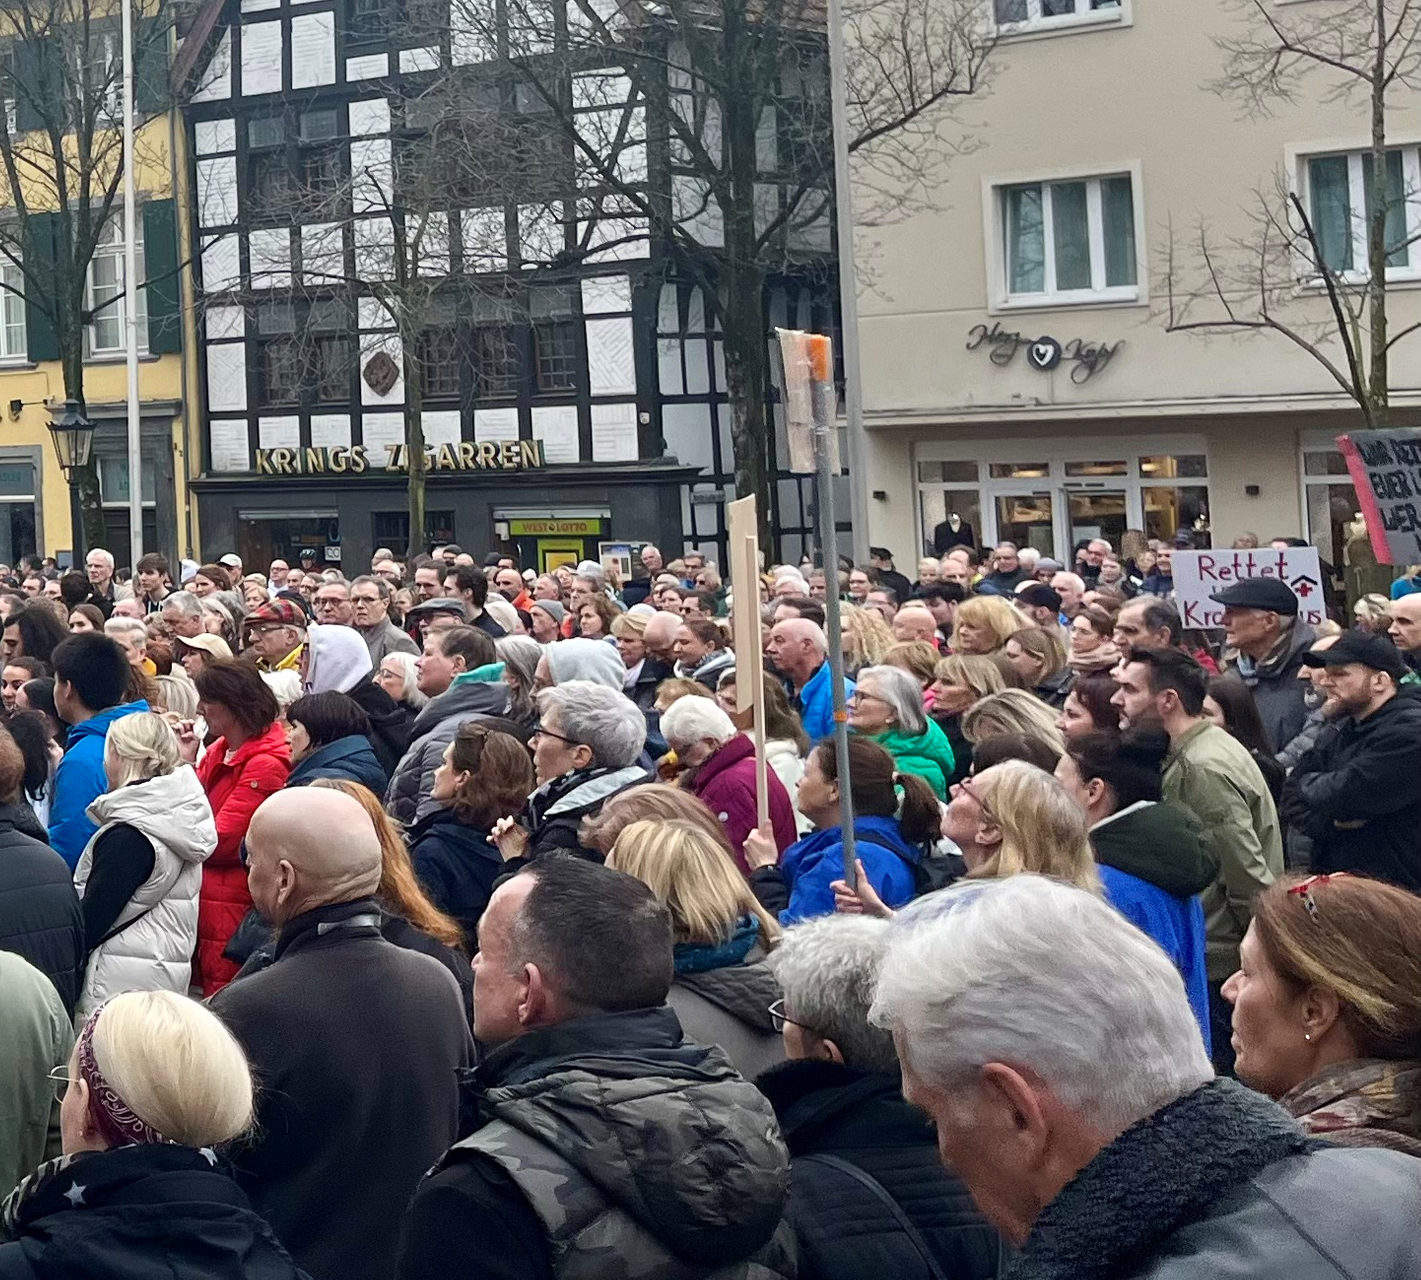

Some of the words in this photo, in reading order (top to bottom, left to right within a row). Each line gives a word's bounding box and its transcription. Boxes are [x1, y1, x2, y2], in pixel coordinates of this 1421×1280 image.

[255, 445, 367, 474] KRINGS
[384, 439, 544, 472] ZIGARREN
[522, 522, 547, 532] WEST
[557, 522, 587, 532] LOTTO
[1198, 552, 1289, 581] Rettet
